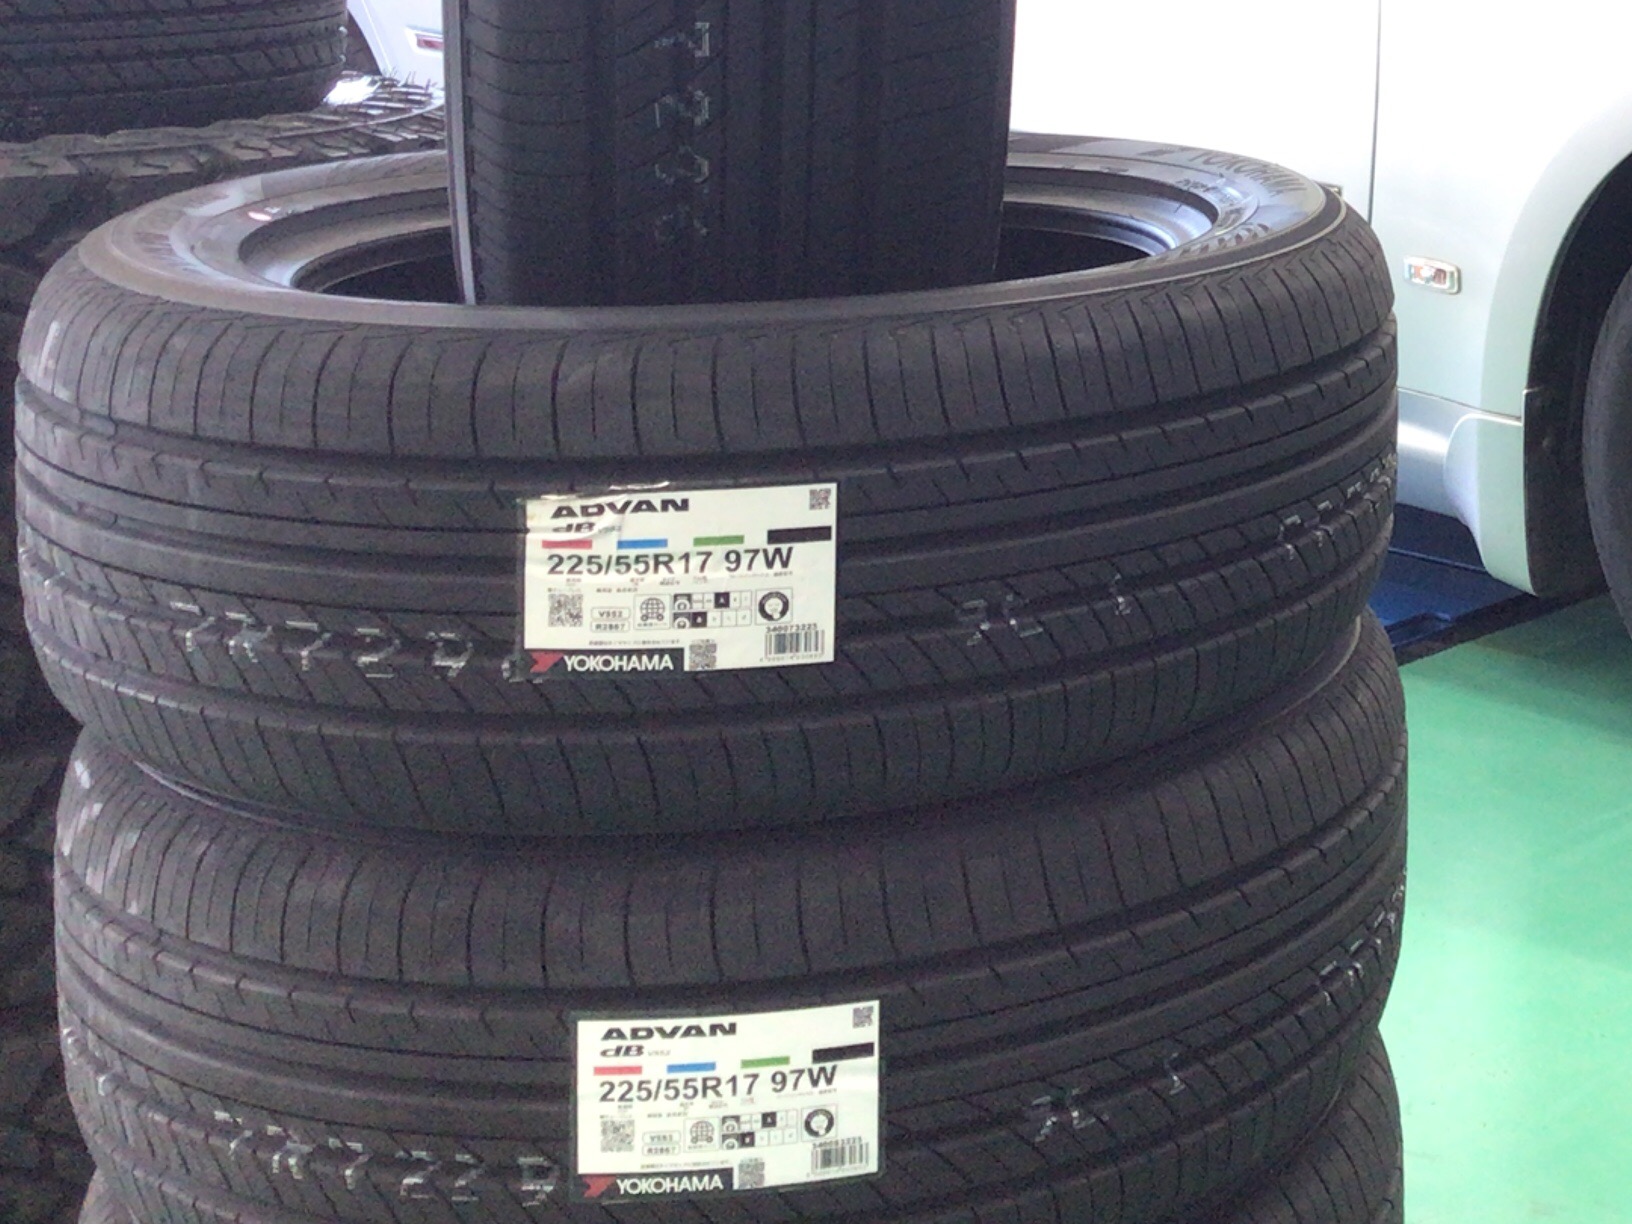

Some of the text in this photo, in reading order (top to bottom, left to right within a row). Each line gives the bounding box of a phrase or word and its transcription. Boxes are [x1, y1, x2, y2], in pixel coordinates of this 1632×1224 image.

[550, 498, 689, 519] ADVAN
[547, 547, 793, 575] 225/55R17 97W
[563, 654, 674, 671] YOKOHAMA
[601, 1022, 737, 1041] ADVAN
[599, 1044, 645, 1058] dB
[599, 1065, 838, 1102] 225/55R17 97W
[616, 1174, 725, 1194] YOKOHAMA
